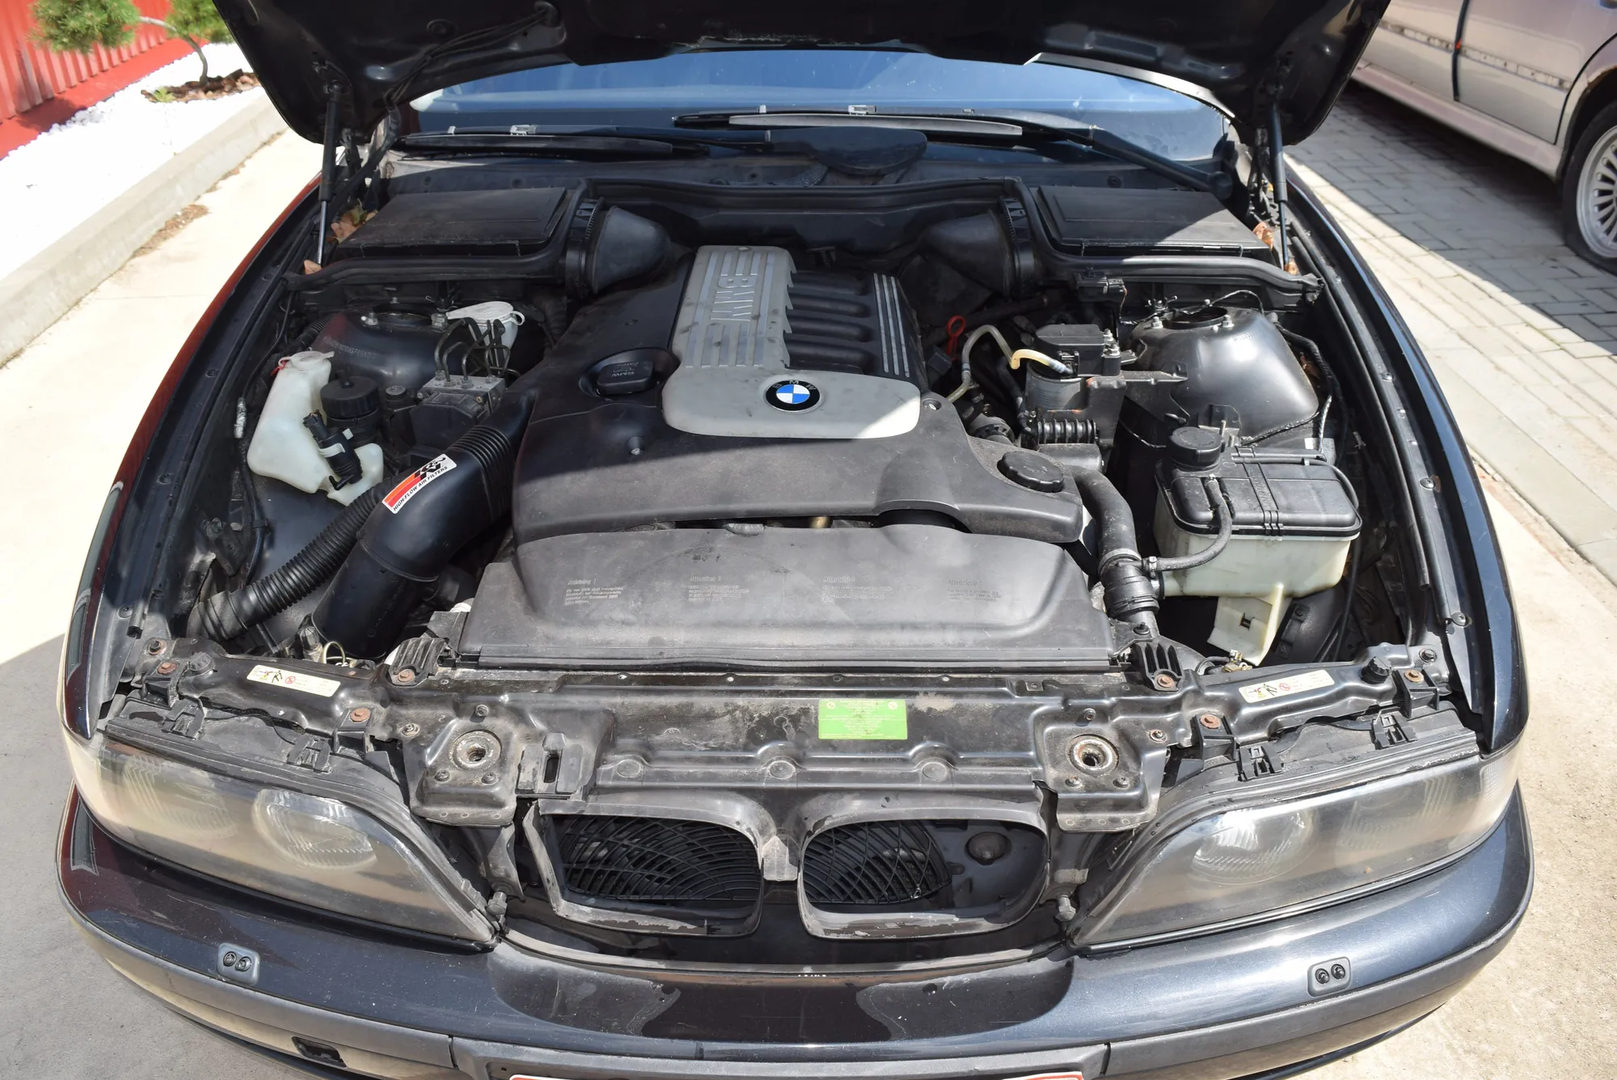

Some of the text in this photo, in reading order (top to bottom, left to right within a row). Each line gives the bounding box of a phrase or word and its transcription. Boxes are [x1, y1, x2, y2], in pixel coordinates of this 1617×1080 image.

[393, 466, 448, 511] HIGH-FLOW AIR FILTERS
